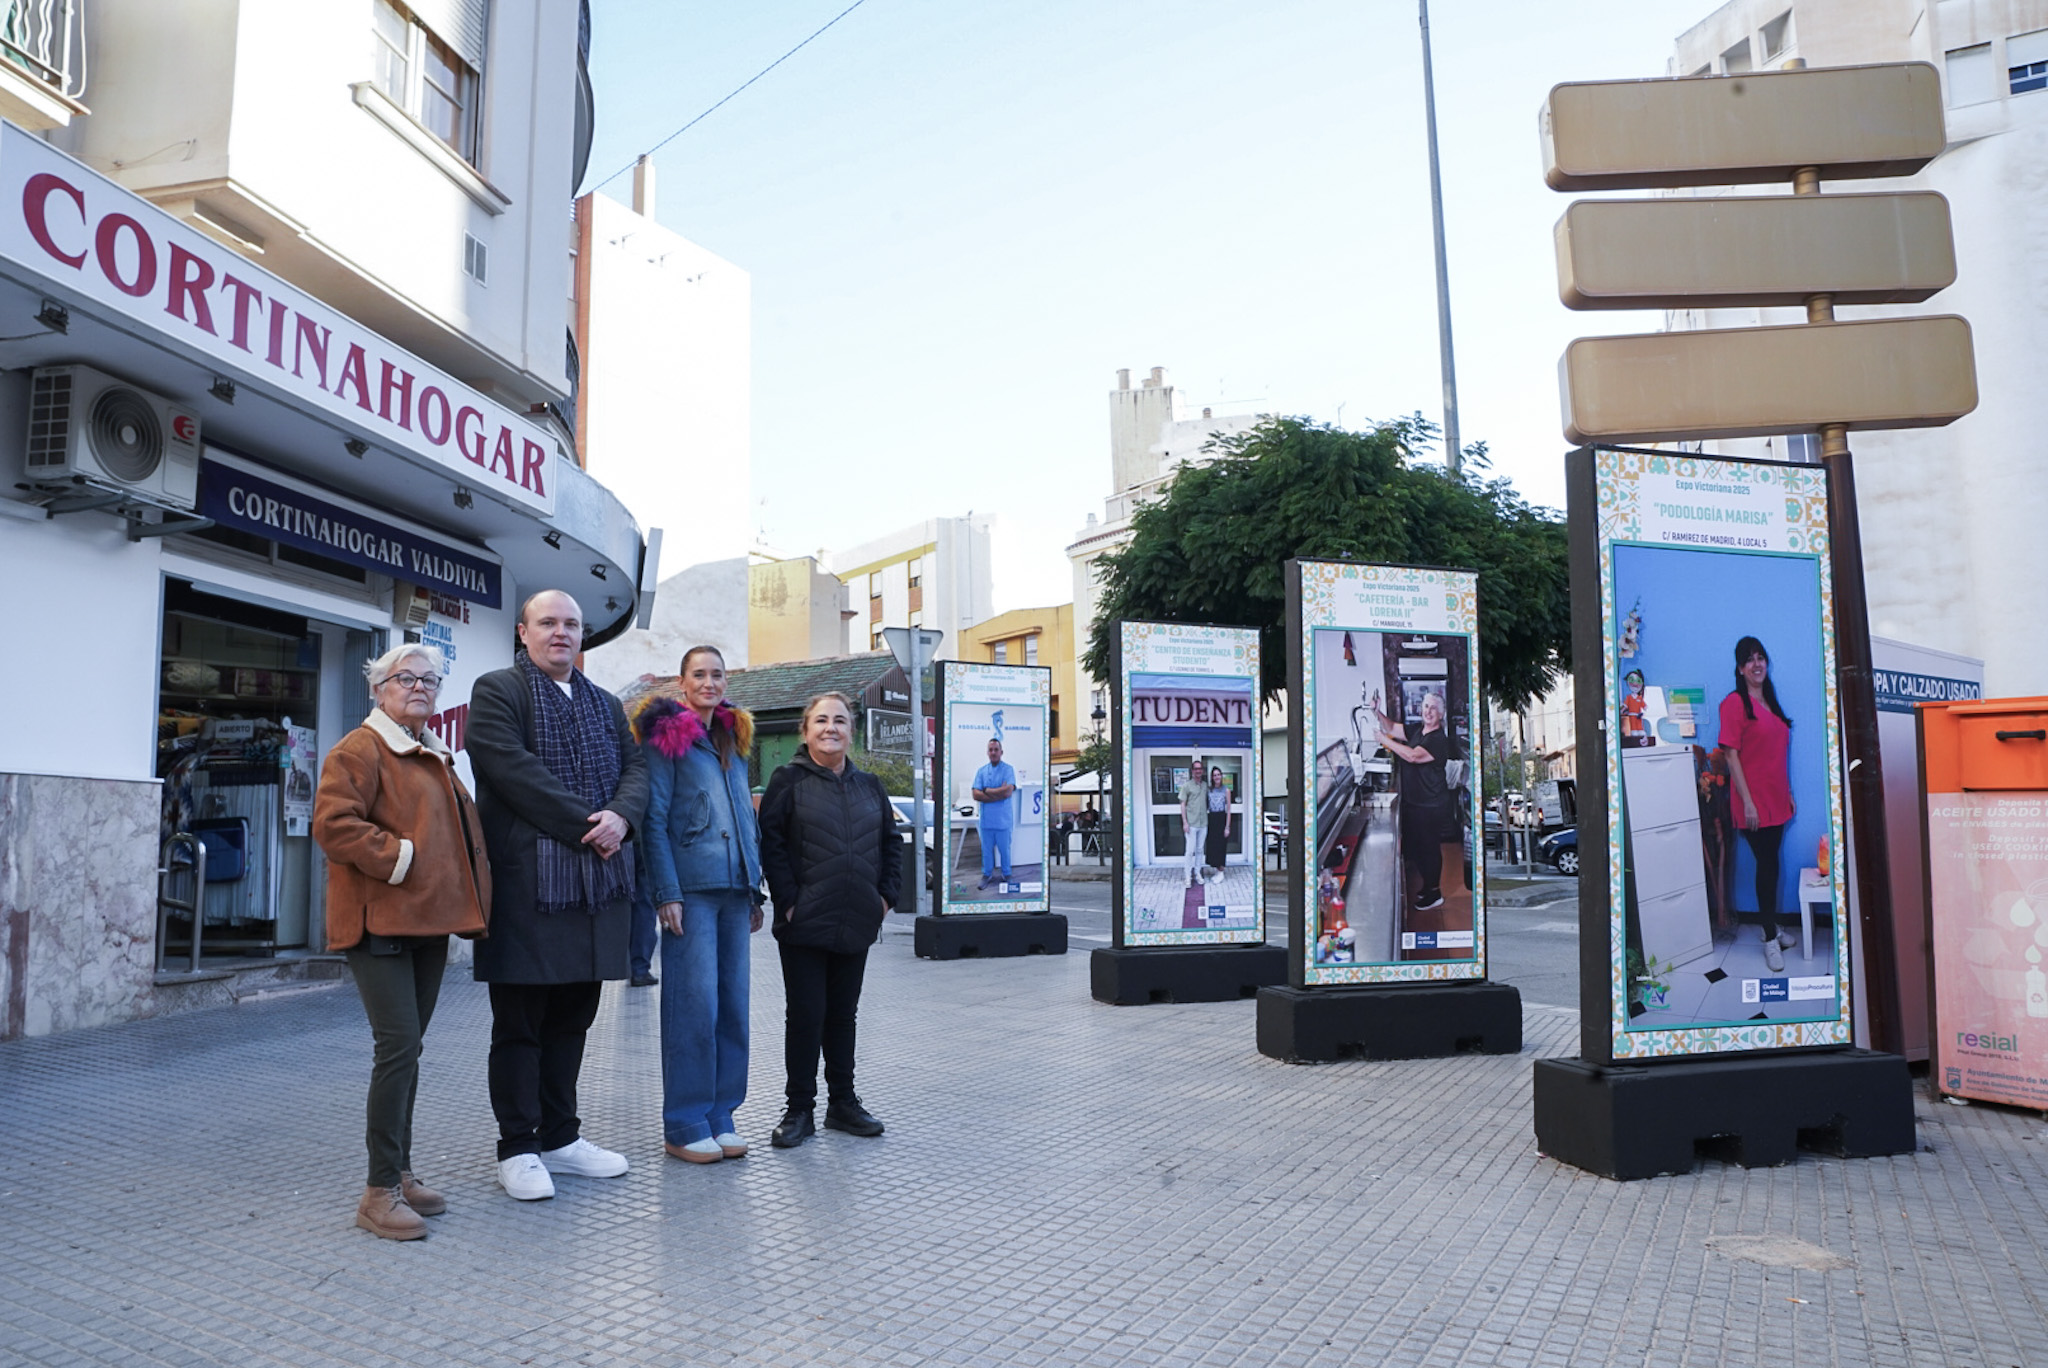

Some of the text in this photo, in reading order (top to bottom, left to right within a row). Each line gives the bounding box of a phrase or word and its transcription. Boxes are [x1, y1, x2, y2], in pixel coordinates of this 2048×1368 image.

[22, 172, 546, 498] CORTINAHOGAR
[1675, 480, 1750, 495] Expo Victoriana 2025
[1725, 509, 1773, 526] MARISA"
[228, 486, 488, 595] CORTINAHOGAR VALDIVIA
[1662, 531, 1671, 541] C/
[1672, 532, 1699, 543] RAMÍREZ
[1701, 535, 1708, 544] DE
[1710, 535, 1736, 546] MADRID,
[1743, 538, 1761, 548] LOCAL
[1762, 539, 1767, 548] 5
[1363, 582, 1376, 591] Expo
[1378, 583, 1406, 592] Victoriana
[1412, 596, 1429, 606] BAR
[1370, 606, 1403, 618] LORENA
[1890, 674, 1898, 694] Y
[1900, 676, 1946, 700] CALZADO
[1947, 682, 1979, 700] USADO
[219, 724, 251, 734] ABIERTO
[1998, 800, 2040, 808] Deposita
[1932, 807, 2040, 817] ACEITE USADO
[1988, 834, 2035, 843] Deposit
[1956, 1032, 2017, 1052] resial
[1967, 1068, 2025, 1082] Ayuntamiento
[2026, 1076, 2036, 1084] de
